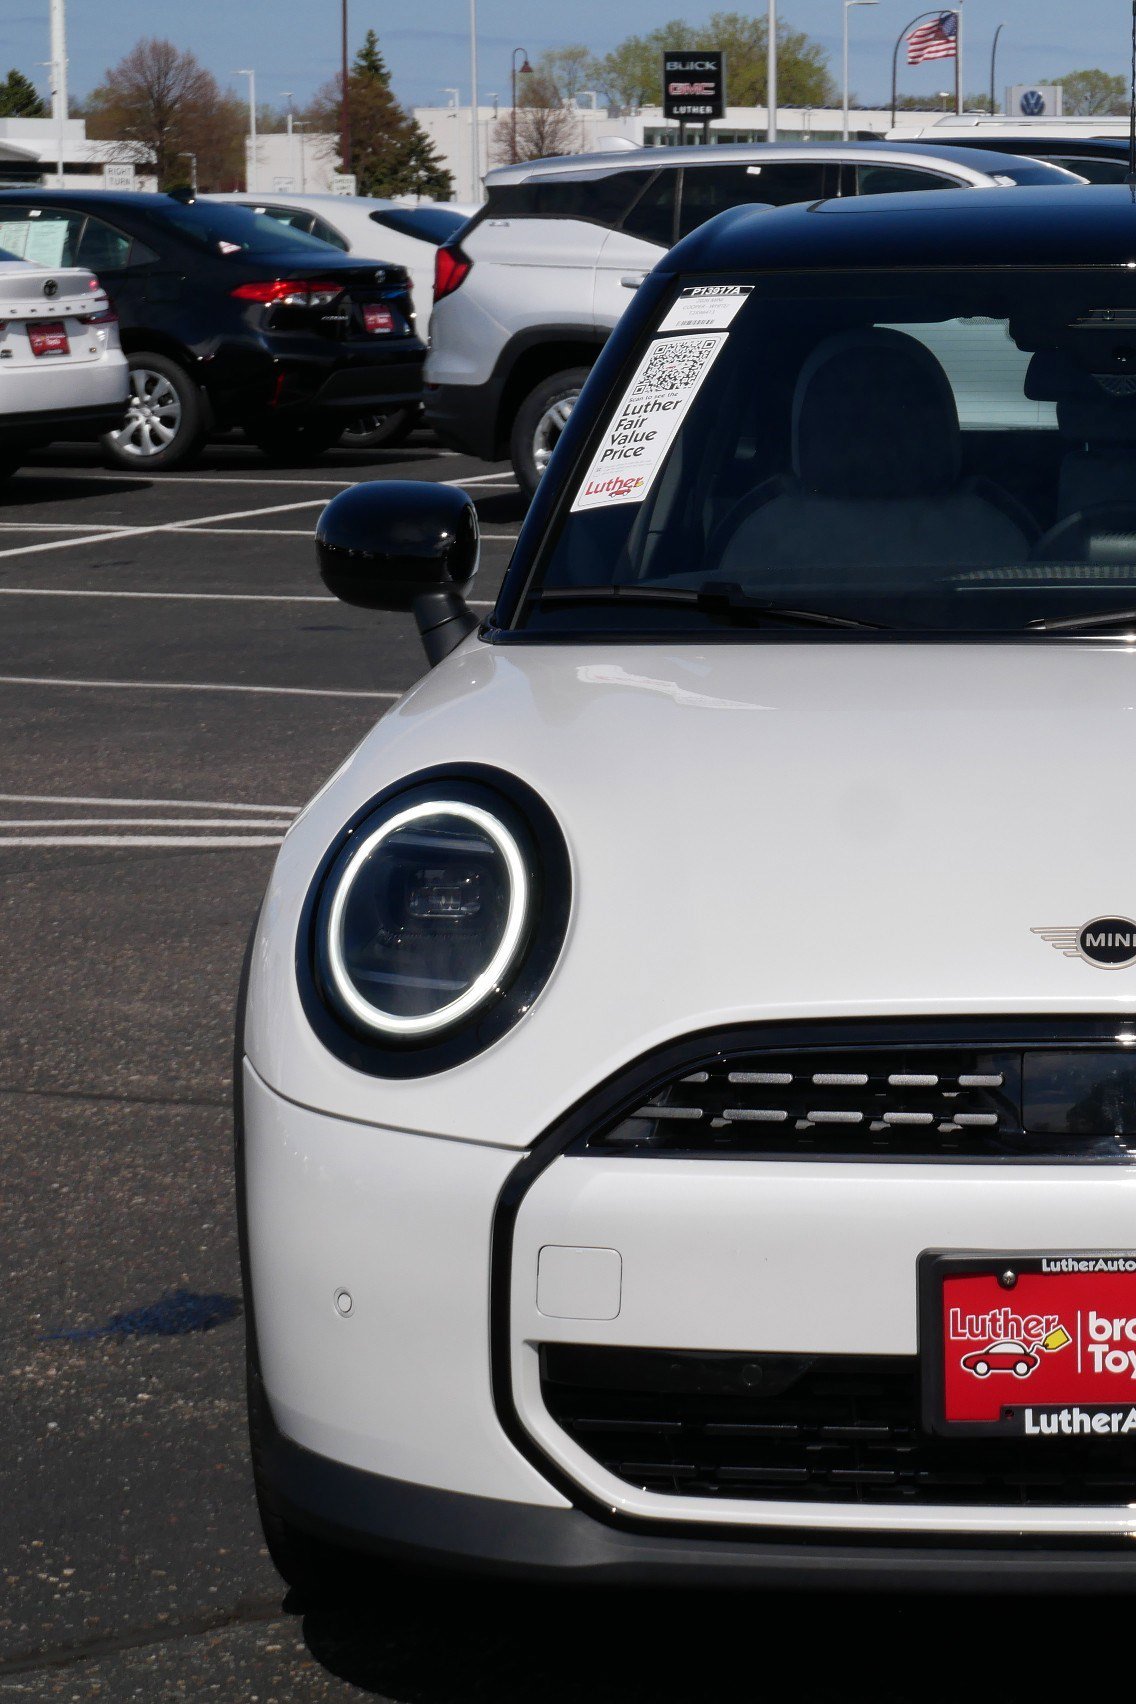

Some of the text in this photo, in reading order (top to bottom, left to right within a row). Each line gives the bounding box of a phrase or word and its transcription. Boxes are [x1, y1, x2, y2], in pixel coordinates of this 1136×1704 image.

[665, 61, 718, 71] BUICK
[668, 82, 716, 95] GMC
[672, 105, 713, 114] LUTHER
[108, 167, 132, 176] RIGHT
[109, 177, 131, 185] TURN
[691, 286, 741, 296] P13917A
[622, 400, 682, 417] Luther
[614, 415, 648, 432] Fair
[610, 430, 658, 446] Value
[600, 445, 645, 463] Price
[585, 476, 644, 495] Luther
[949, 1308, 1060, 1340] Luther
